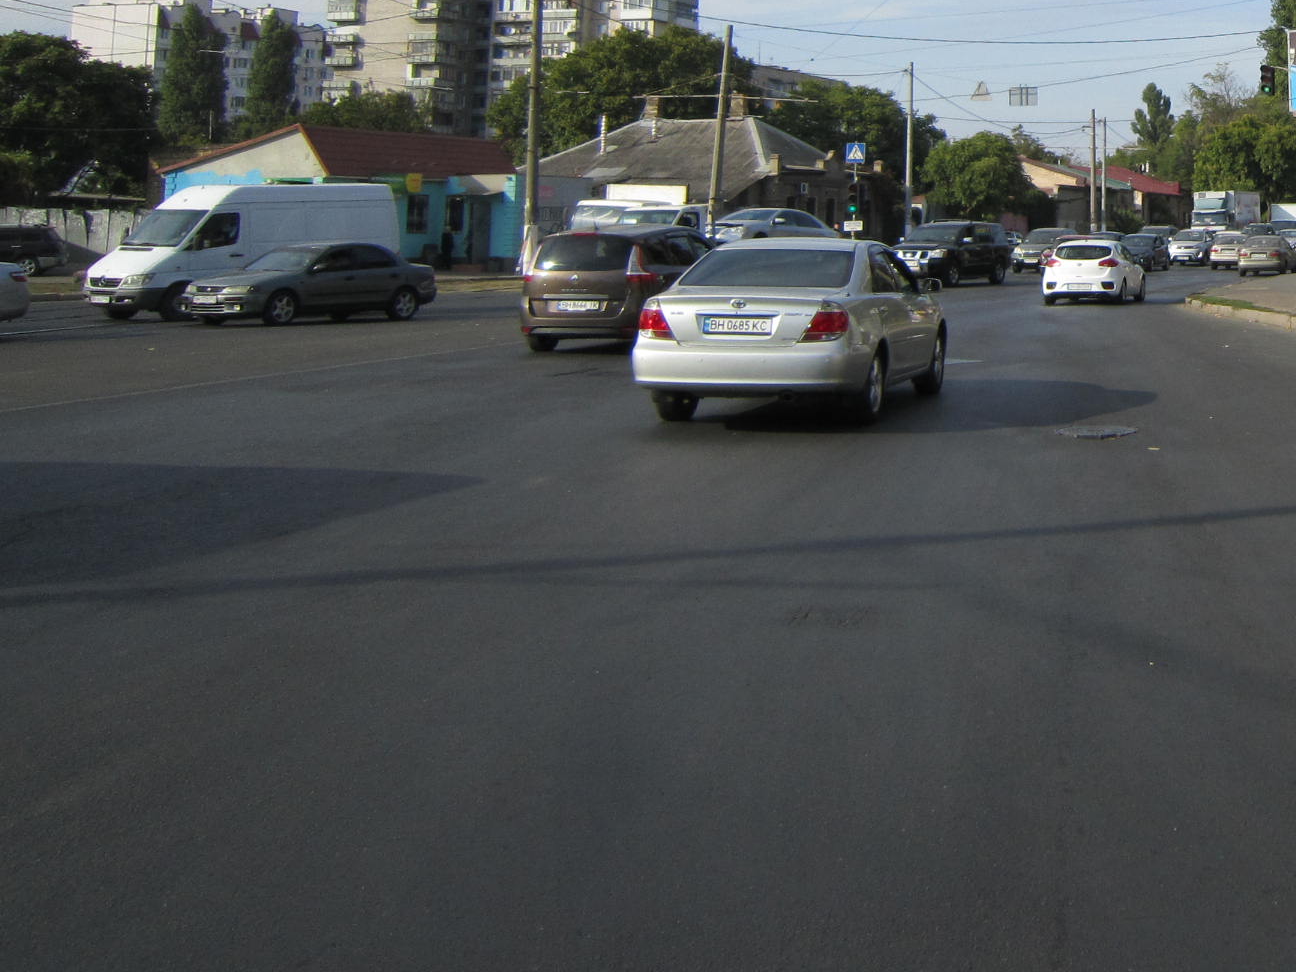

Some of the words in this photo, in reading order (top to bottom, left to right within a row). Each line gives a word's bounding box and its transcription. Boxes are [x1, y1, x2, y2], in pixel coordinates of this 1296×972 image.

[710, 319, 725, 331] BH
[726, 319, 751, 331] 0685
[752, 320, 768, 332] KC
